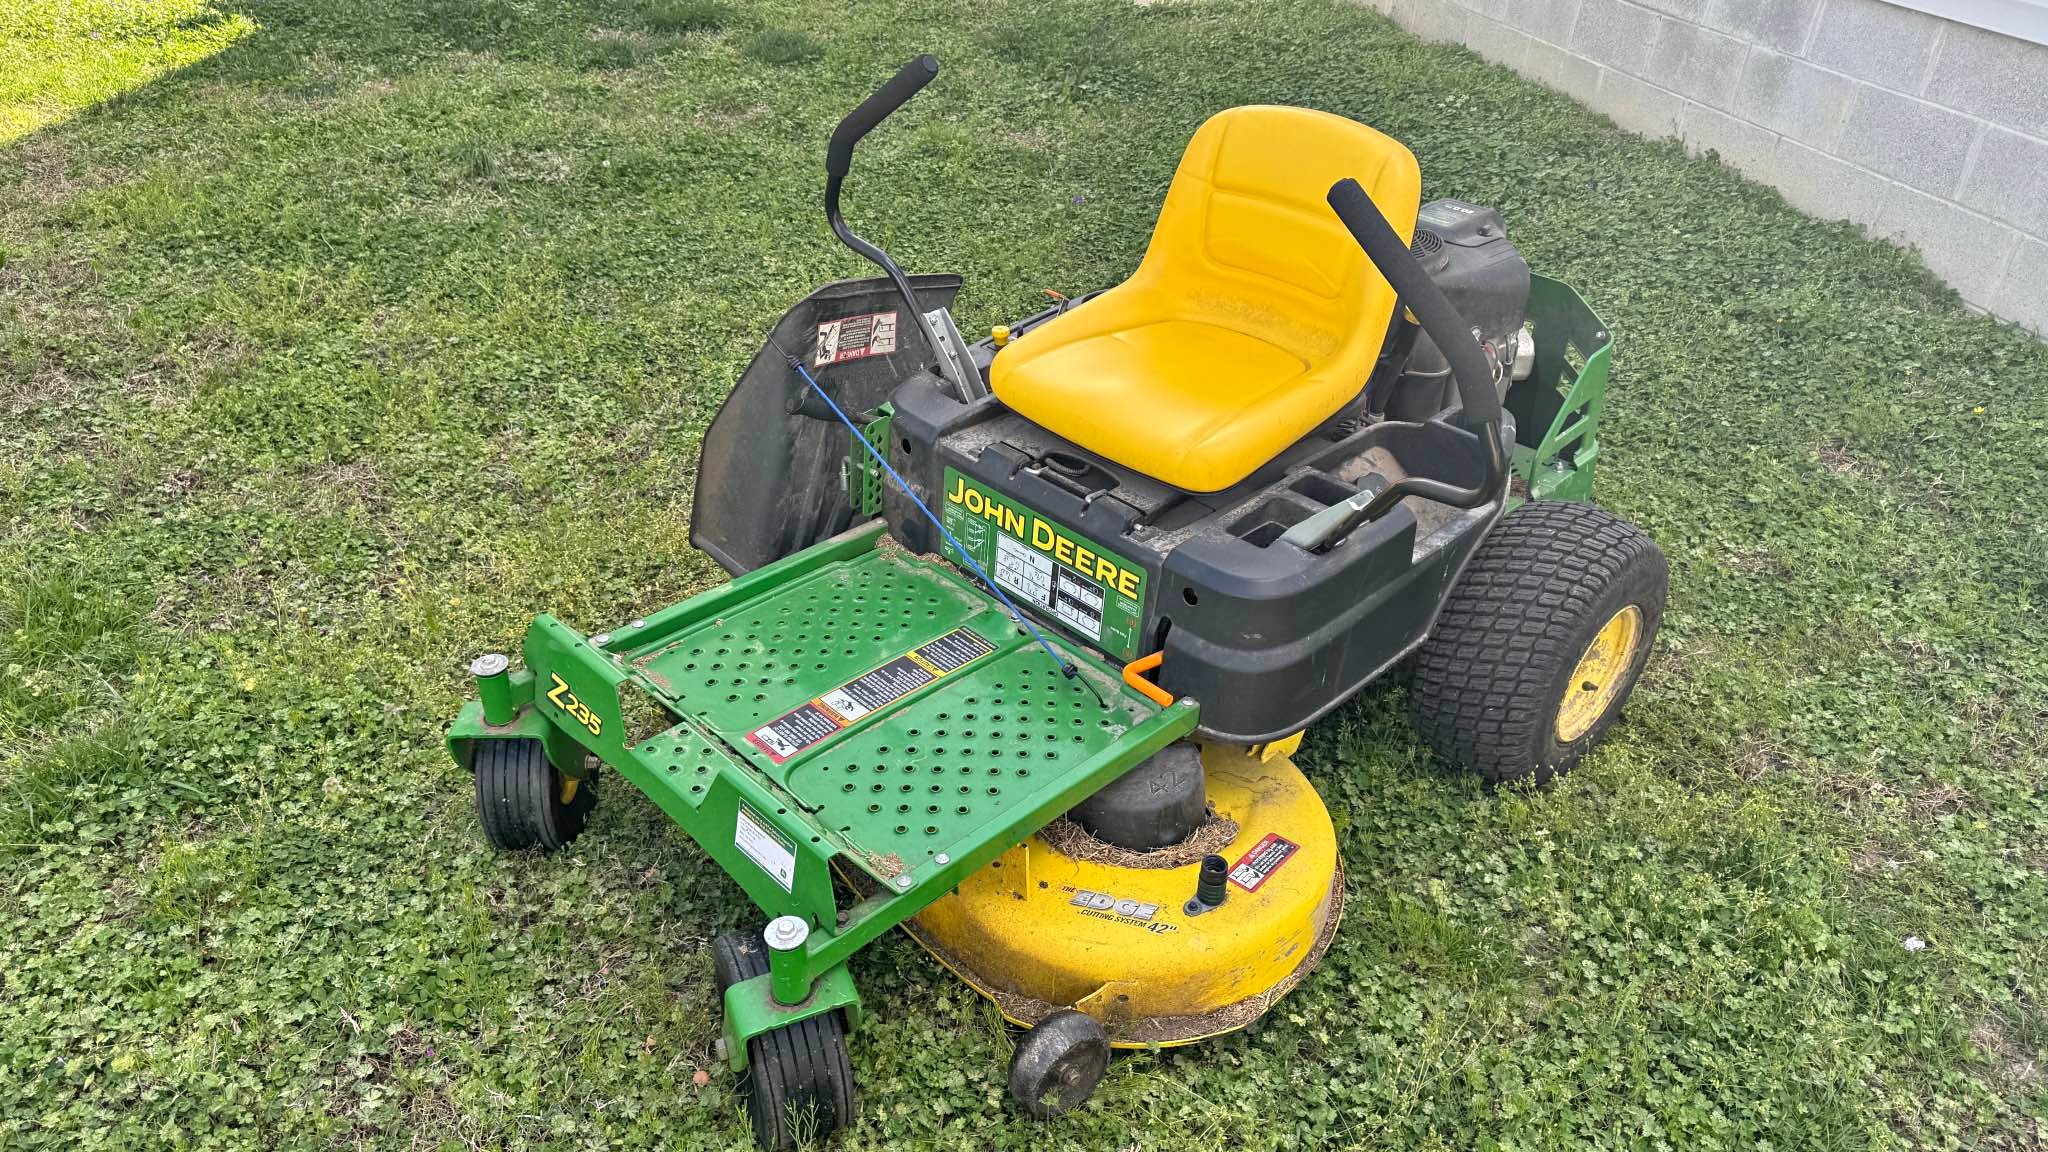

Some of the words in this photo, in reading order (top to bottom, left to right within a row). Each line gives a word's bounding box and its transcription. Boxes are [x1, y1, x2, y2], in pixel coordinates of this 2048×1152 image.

[948, 478, 1026, 539] JOHN
[1032, 517, 1141, 600] DEERE
[1061, 885, 1076, 893] THE
[1069, 889, 1160, 921] EDGE
[1080, 908, 1115, 921] CUTTING
[1114, 916, 1147, 928] SYSTEM
